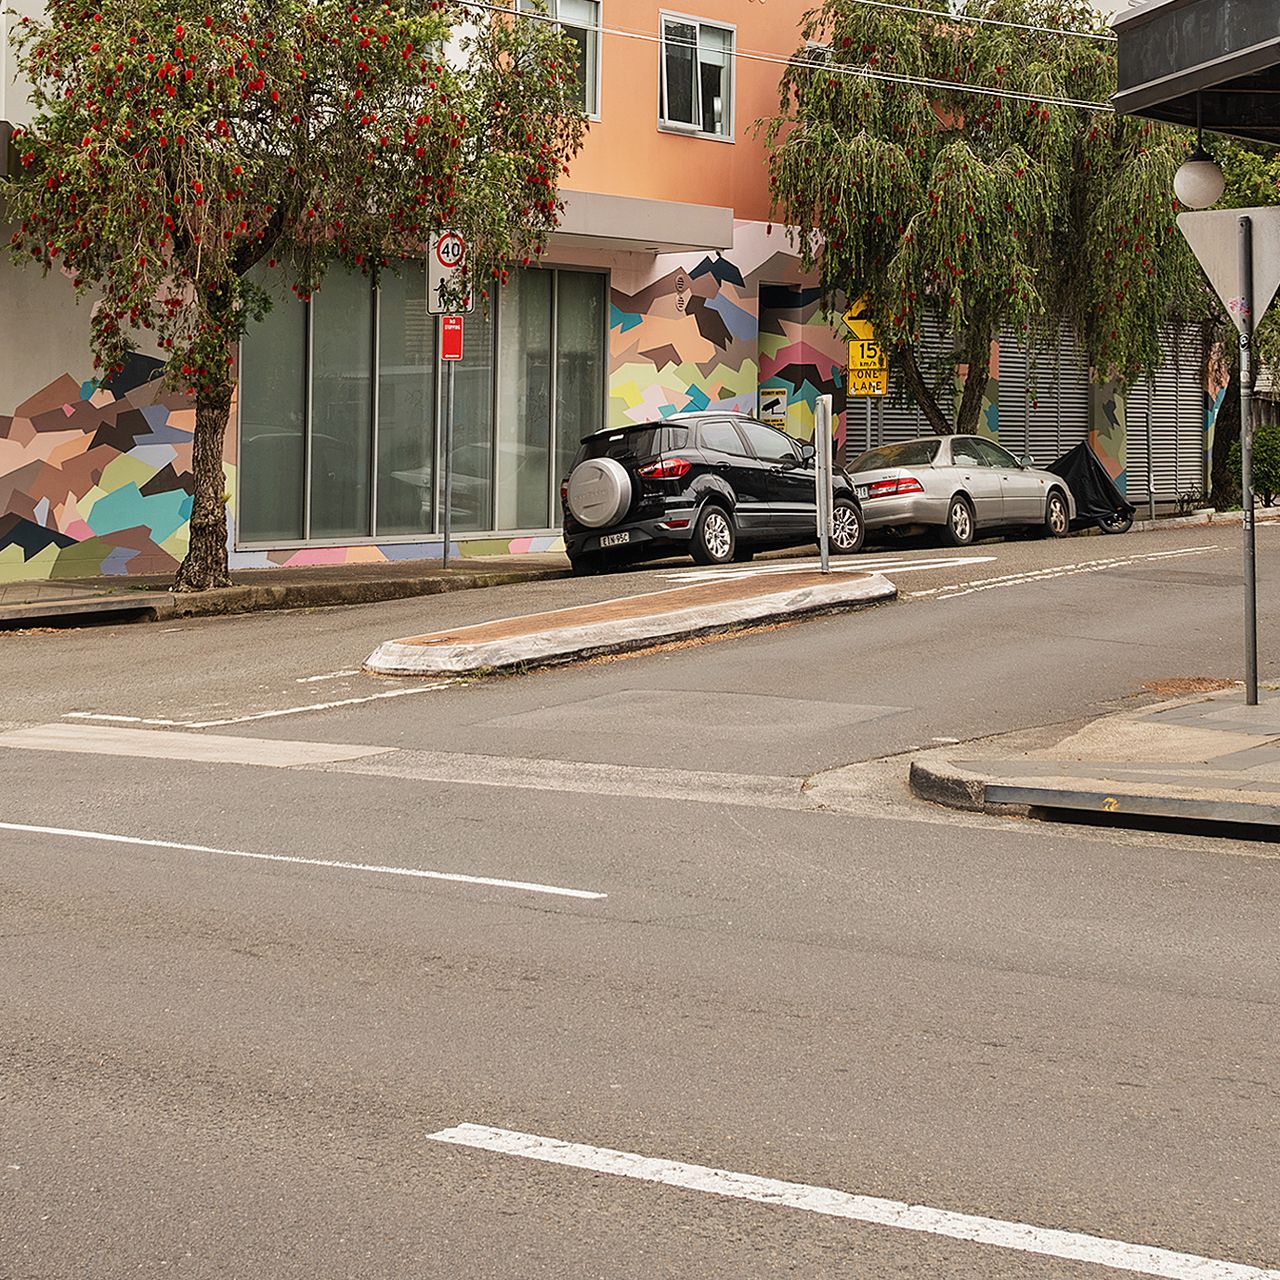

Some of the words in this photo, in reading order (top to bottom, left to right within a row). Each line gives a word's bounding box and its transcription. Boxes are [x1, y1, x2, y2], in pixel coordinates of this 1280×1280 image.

[441, 243, 460, 258] 40
[860, 342, 877, 359] 15
[856, 370, 879, 379] ONE
[852, 381, 882, 393] LANE
